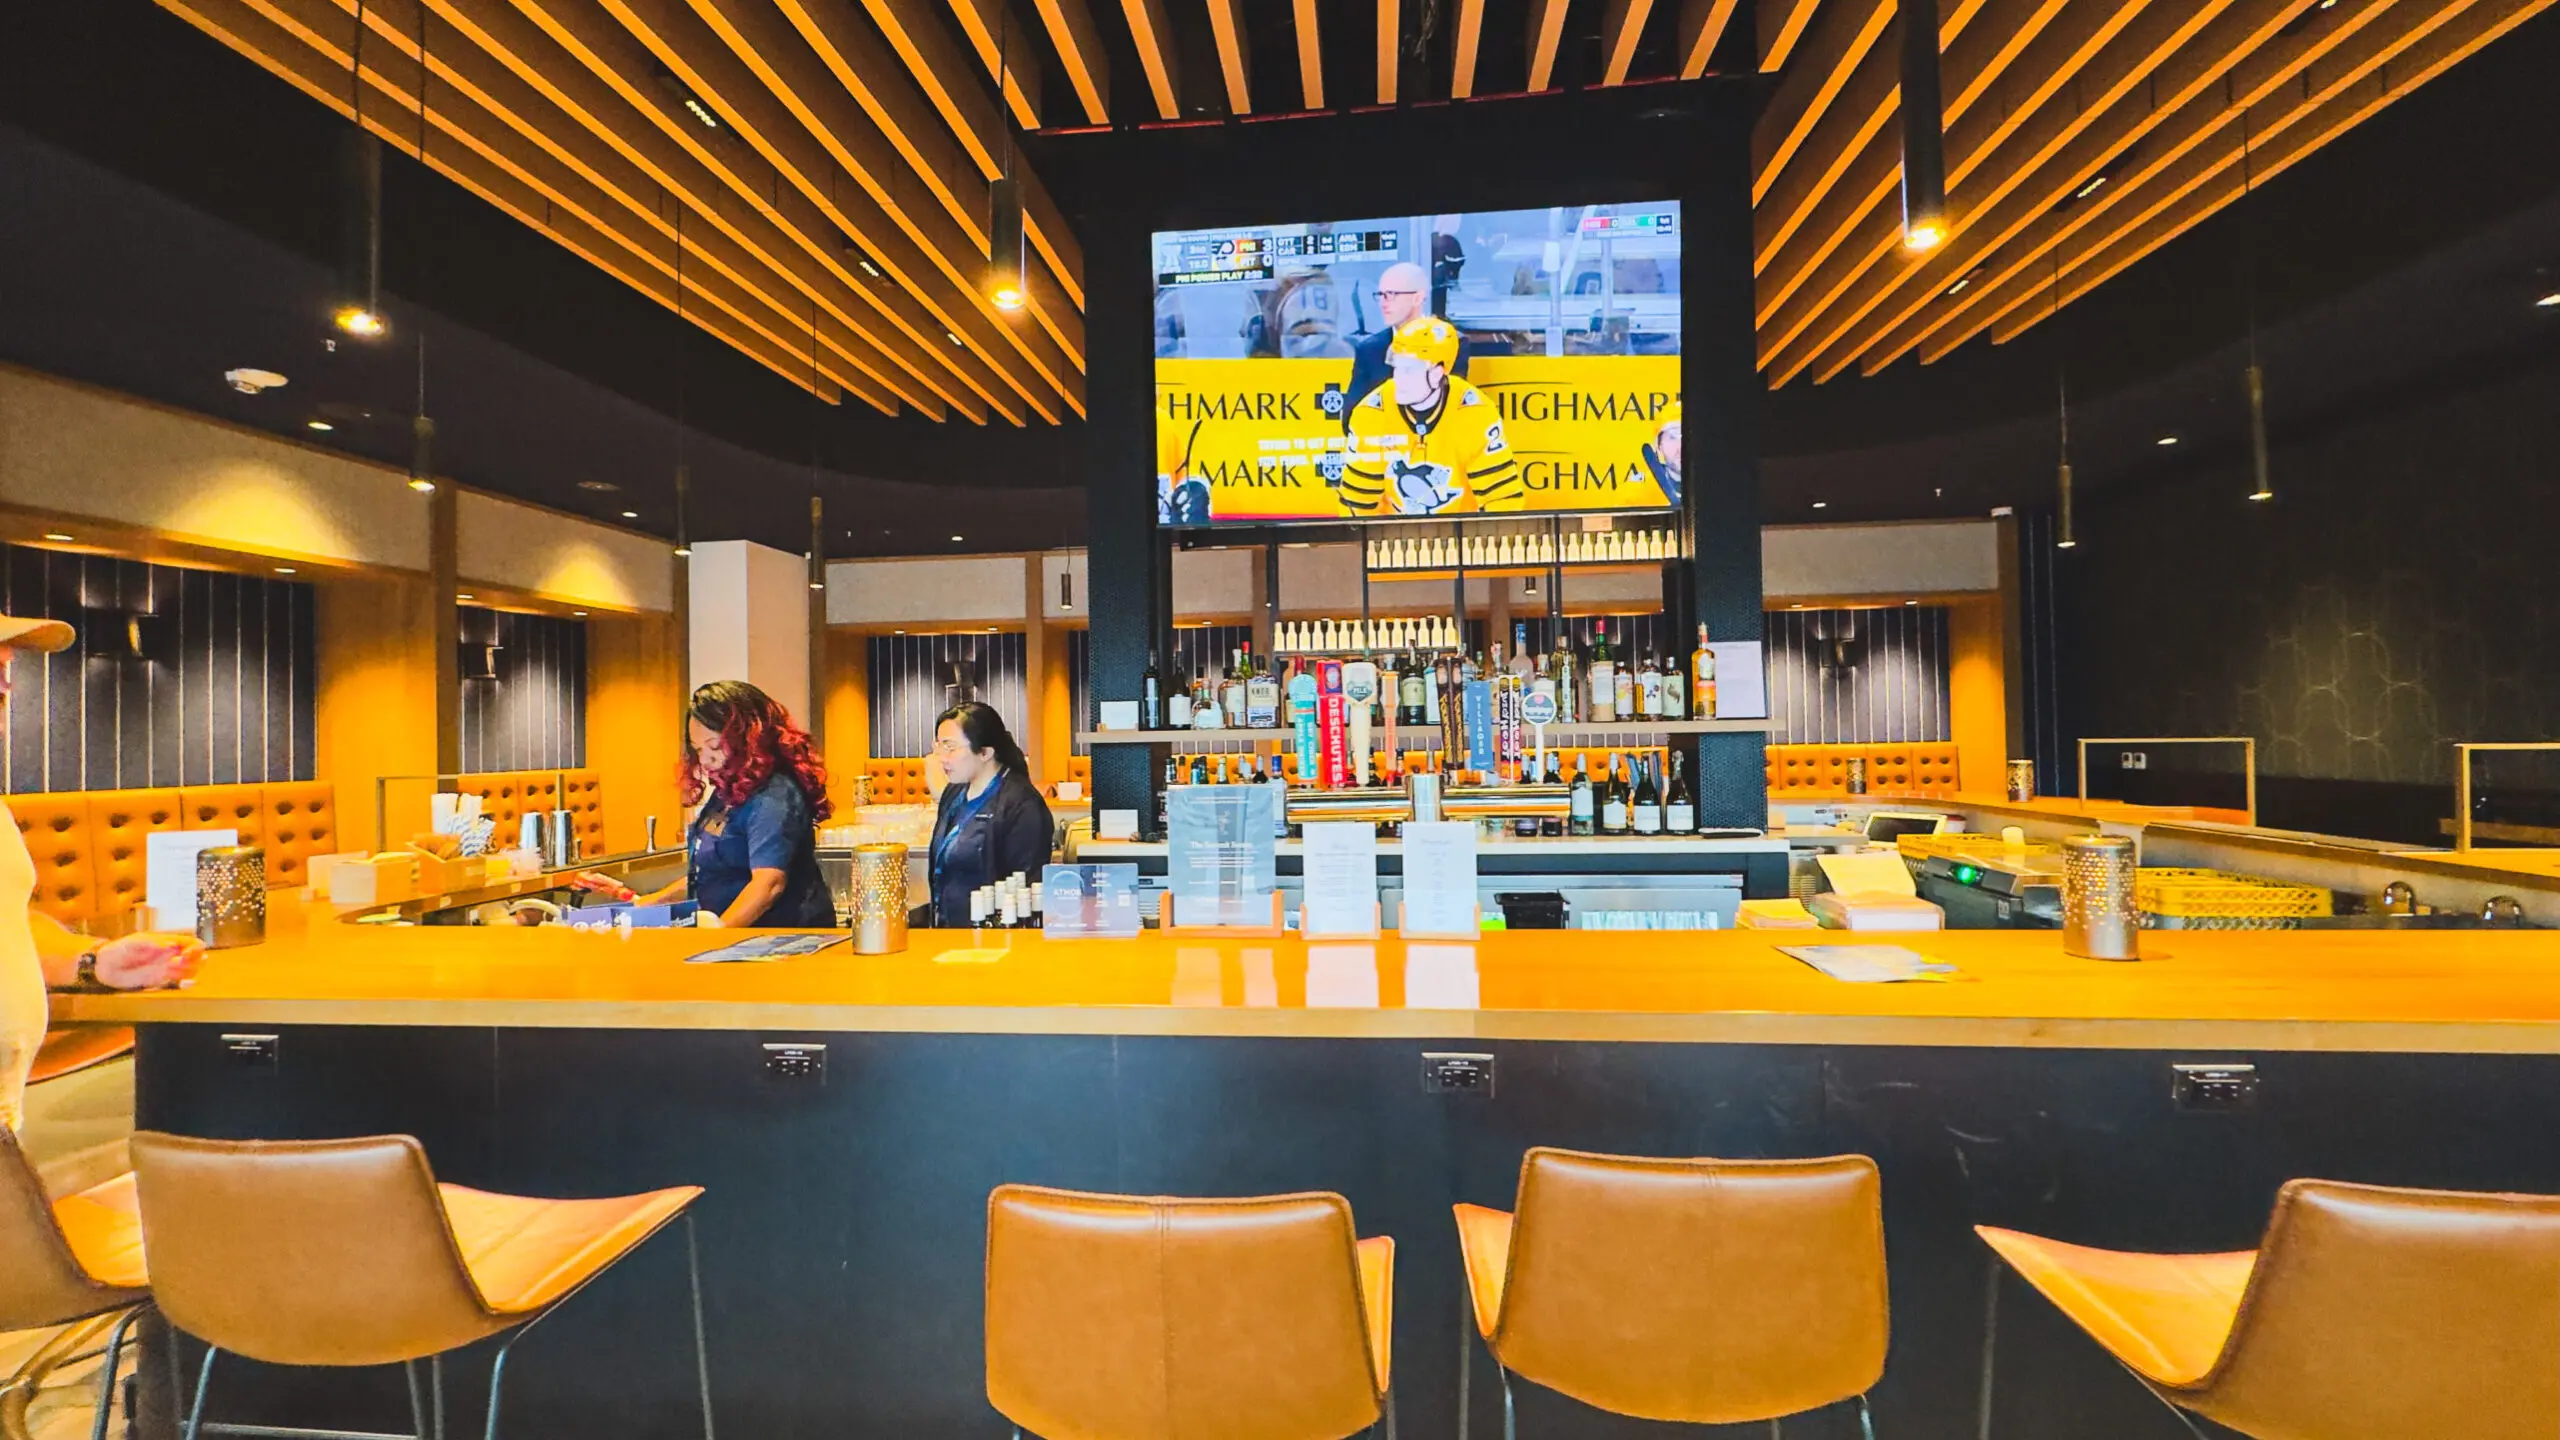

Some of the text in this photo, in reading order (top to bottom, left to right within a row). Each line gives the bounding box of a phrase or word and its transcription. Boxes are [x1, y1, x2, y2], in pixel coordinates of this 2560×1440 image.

[1263, 239, 1272, 251] 3
[1263, 254, 1272, 266] 0
[1191, 273, 1220, 282] POWER
[1221, 271, 1244, 281] PLAY
[1497, 391, 1682, 421] IGHMAR
[1475, 695, 1485, 755] VILLAGER
[1328, 697, 1343, 783] DESCHUTES
